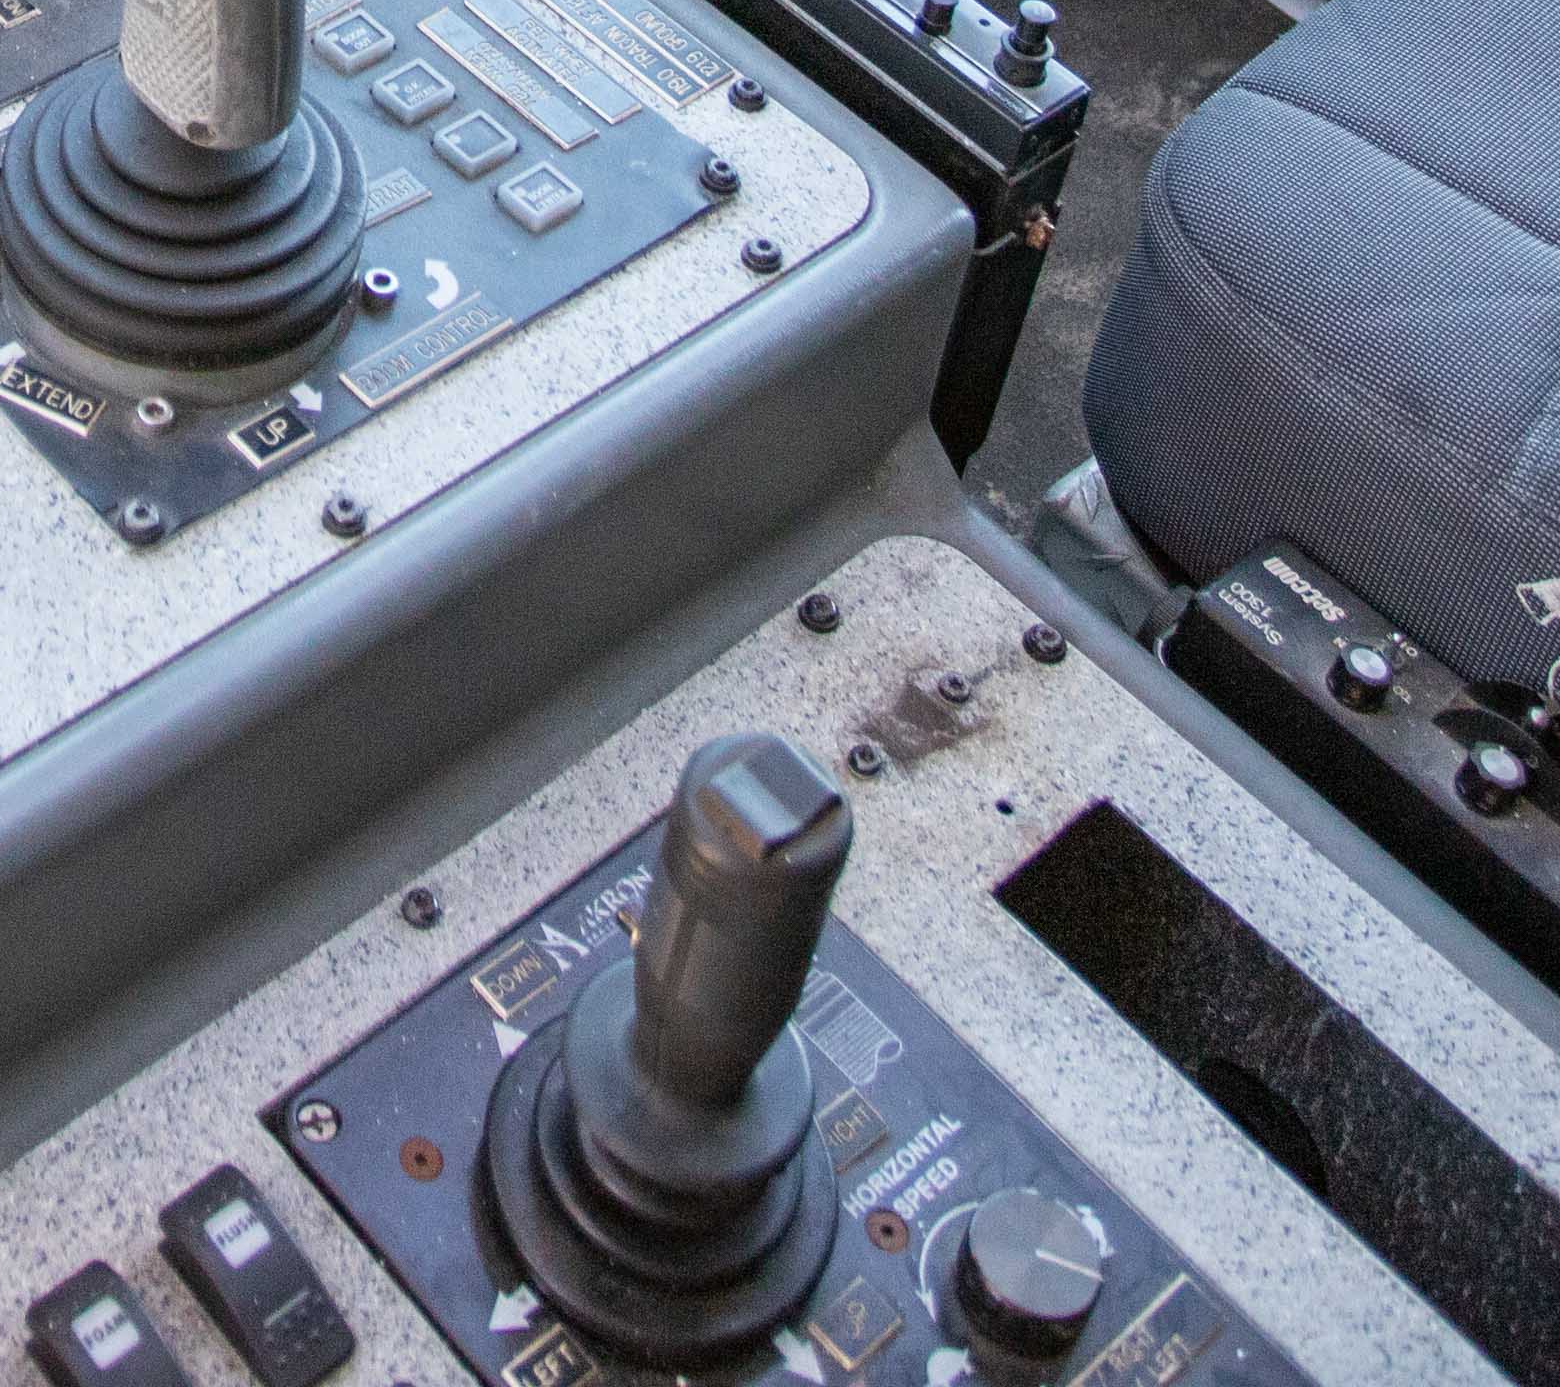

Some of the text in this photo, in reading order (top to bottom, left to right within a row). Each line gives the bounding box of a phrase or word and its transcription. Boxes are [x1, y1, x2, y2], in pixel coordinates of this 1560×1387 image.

[413, 303, 502, 362] CONTROL
[3, 367, 94, 422] EXTEND
[254, 418, 290, 450] UP
[1218, 589, 1283, 645] System
[1231, 582, 1273, 618] 1300
[486, 953, 542, 1000] DOWN
[844, 1111, 965, 1219] HORIZONTAL
[892, 1158, 961, 1221] SPEED
[212, 1214, 262, 1247] FLUSH
[80, 1311, 129, 1347] FOAM
